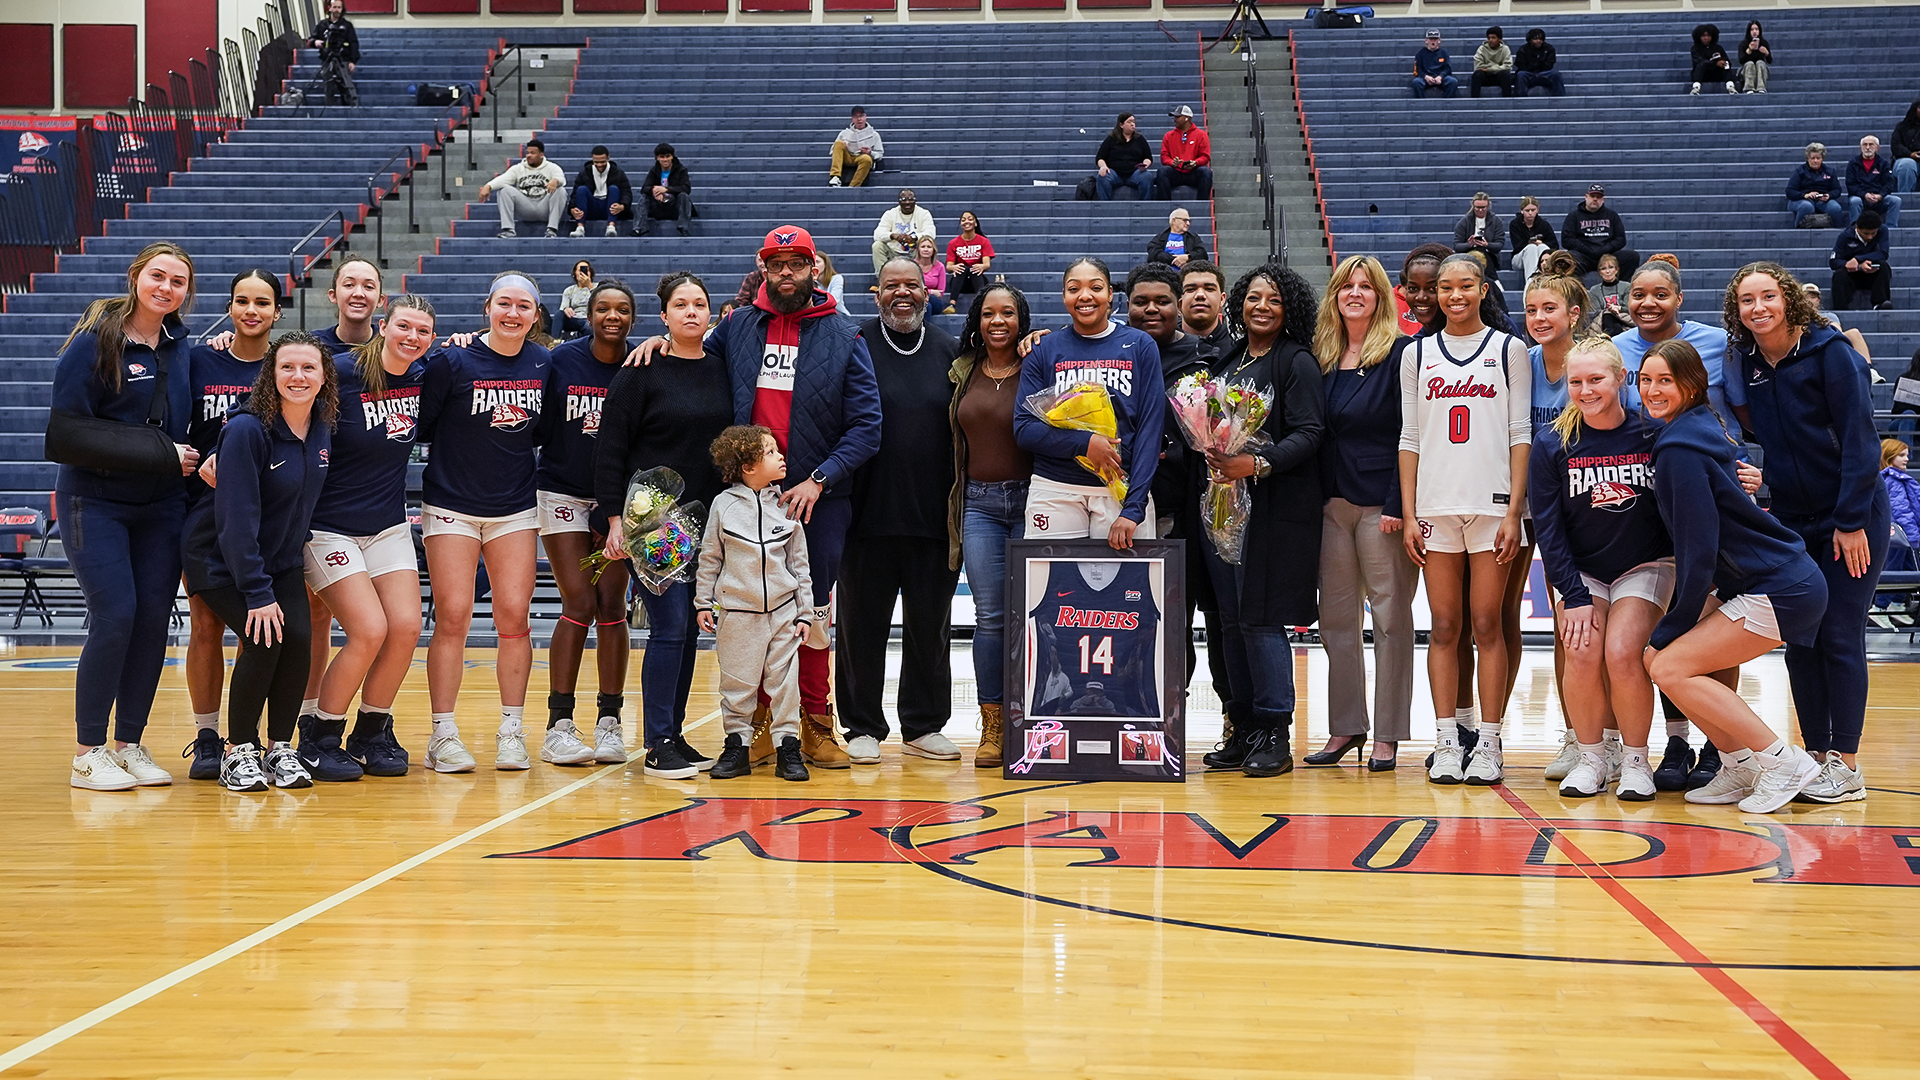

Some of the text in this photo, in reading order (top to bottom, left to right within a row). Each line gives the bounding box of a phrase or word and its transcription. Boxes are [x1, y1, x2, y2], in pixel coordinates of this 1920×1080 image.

[0, 120, 30, 128] ATIONAL
[957, 245, 981, 256] SHIP
[1055, 360, 1133, 372] SHIPPENSBURG
[473, 380, 543, 390] SHIPPENSBURG
[1055, 368, 1133, 397] RAIDERS
[1426, 375, 1497, 400] Raiders
[471, 389, 543, 416] RAIDERS
[1449, 405, 1470, 444] 0
[1568, 464, 1656, 498] RAIDERS
[0, 514, 37, 525] RAIDERS
[1055, 606, 1139, 630] RAIDERS
[1078, 635, 1114, 675] 14
